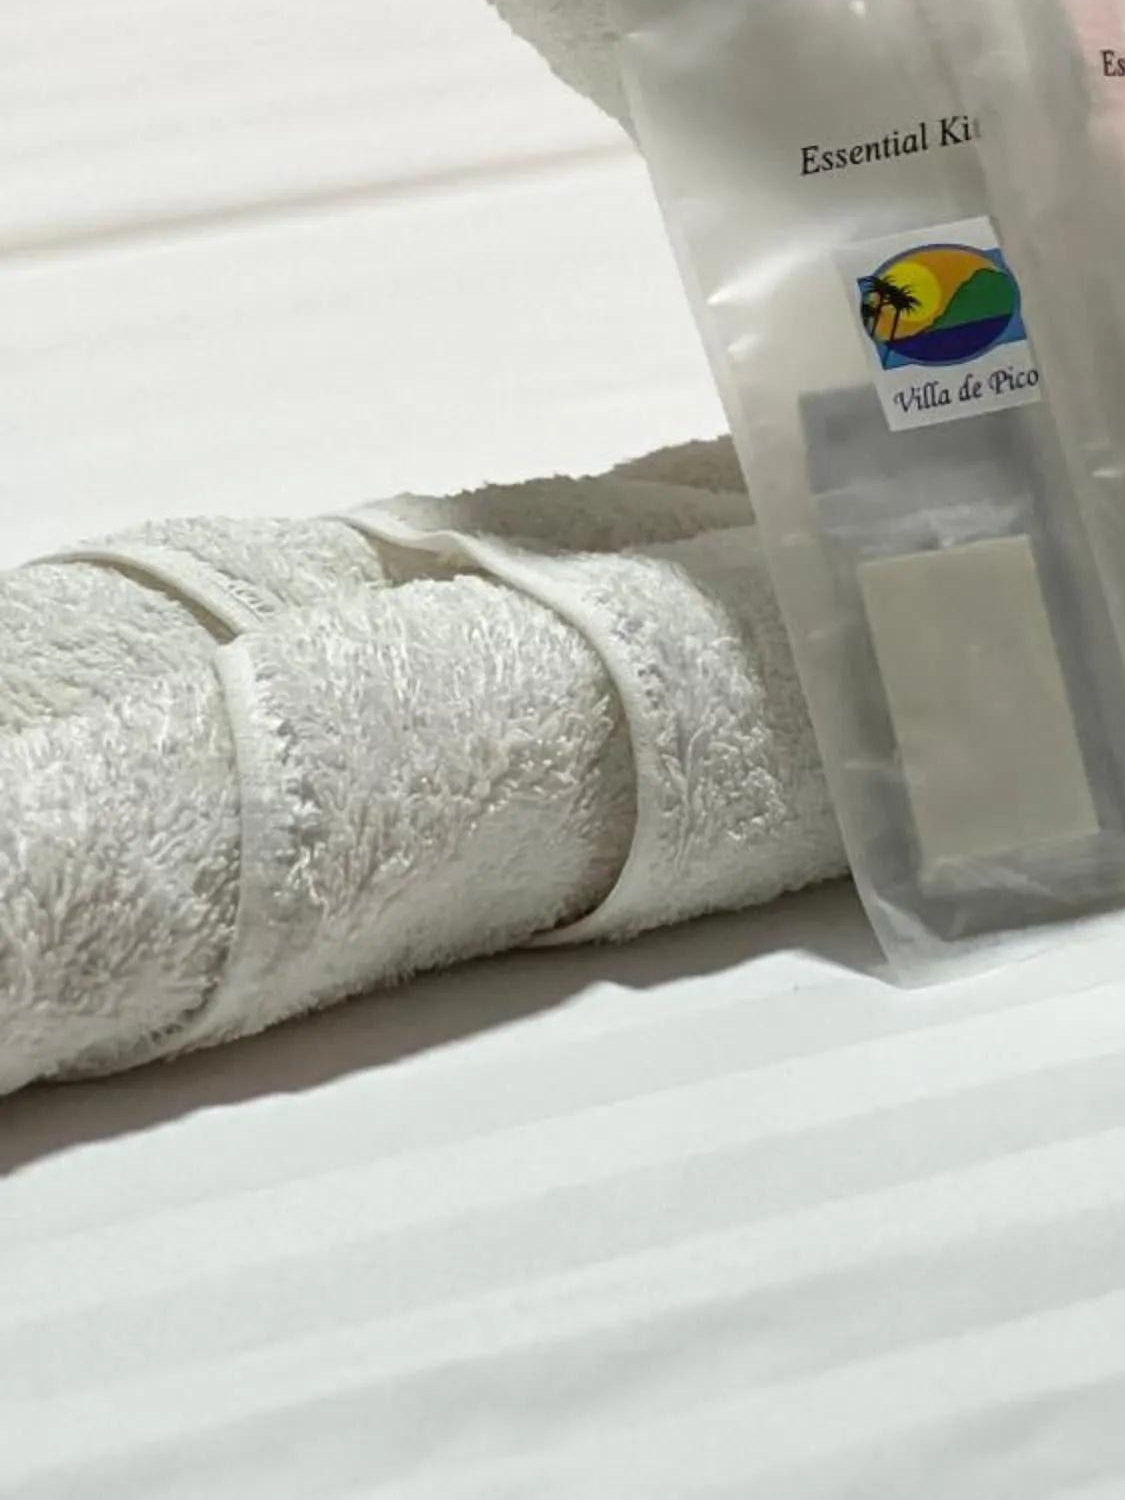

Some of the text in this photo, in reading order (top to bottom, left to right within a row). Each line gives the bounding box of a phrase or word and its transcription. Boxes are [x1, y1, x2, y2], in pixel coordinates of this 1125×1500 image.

[800, 122, 928, 176] Essential
[894, 366, 1039, 413] Villa de Pico
